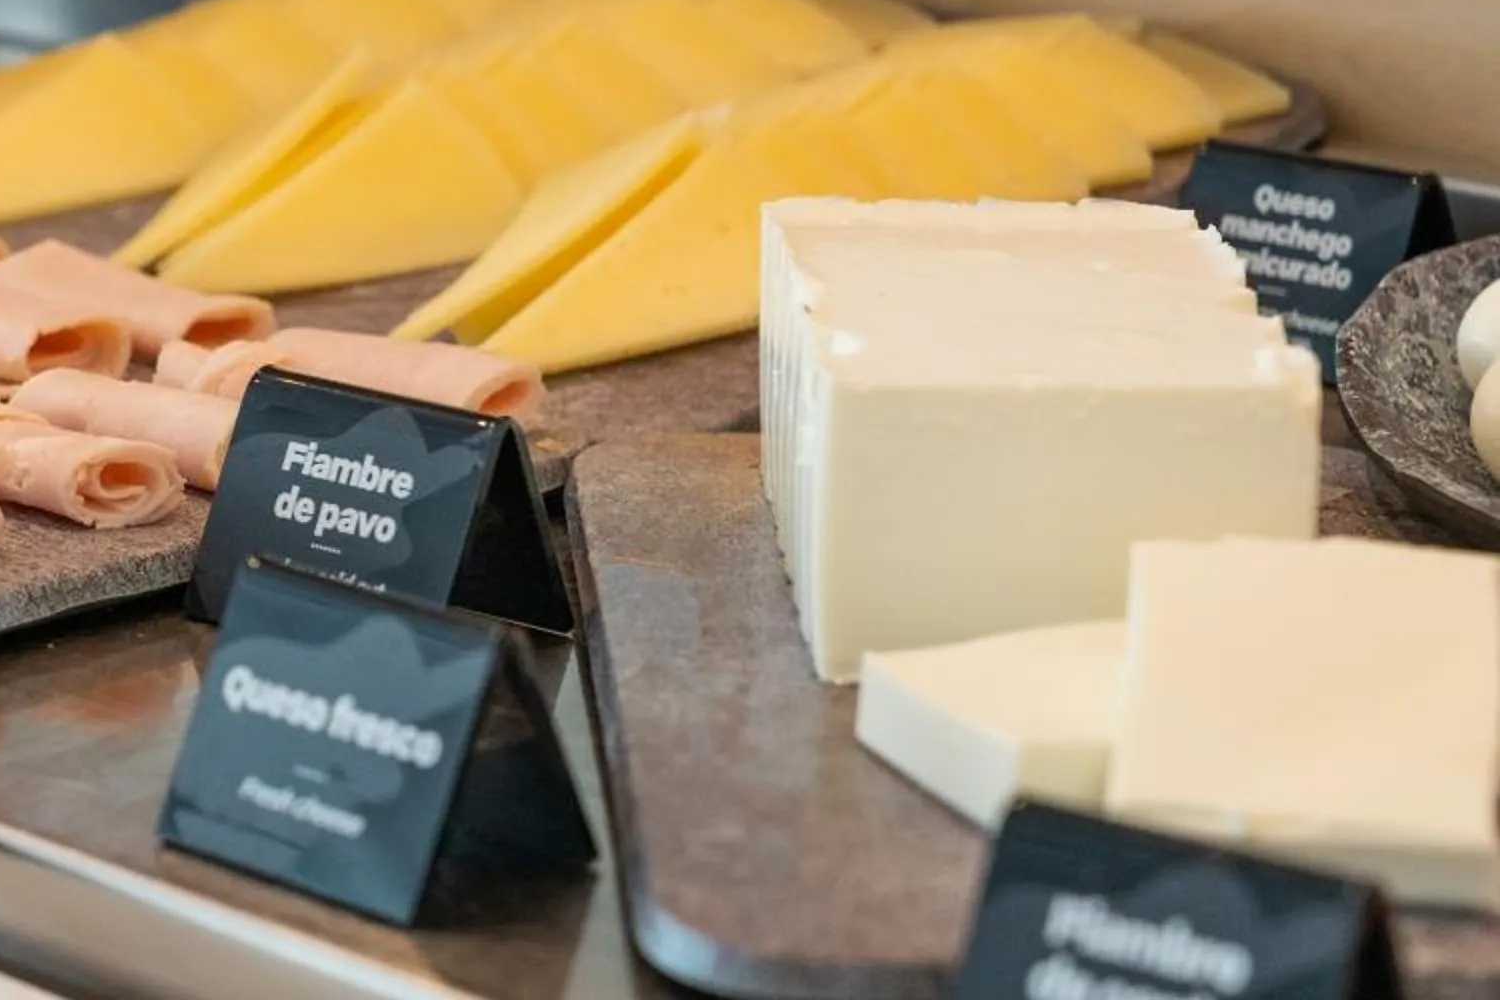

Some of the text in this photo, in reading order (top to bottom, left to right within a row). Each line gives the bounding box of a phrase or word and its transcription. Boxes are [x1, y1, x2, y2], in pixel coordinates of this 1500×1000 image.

[1253, 184, 1336, 221] Queso
[1220, 214, 1353, 261] manchego
[281, 441, 414, 498] Fiambre
[273, 485, 396, 543] de pavo
[222, 664, 443, 768] Queso fresco
